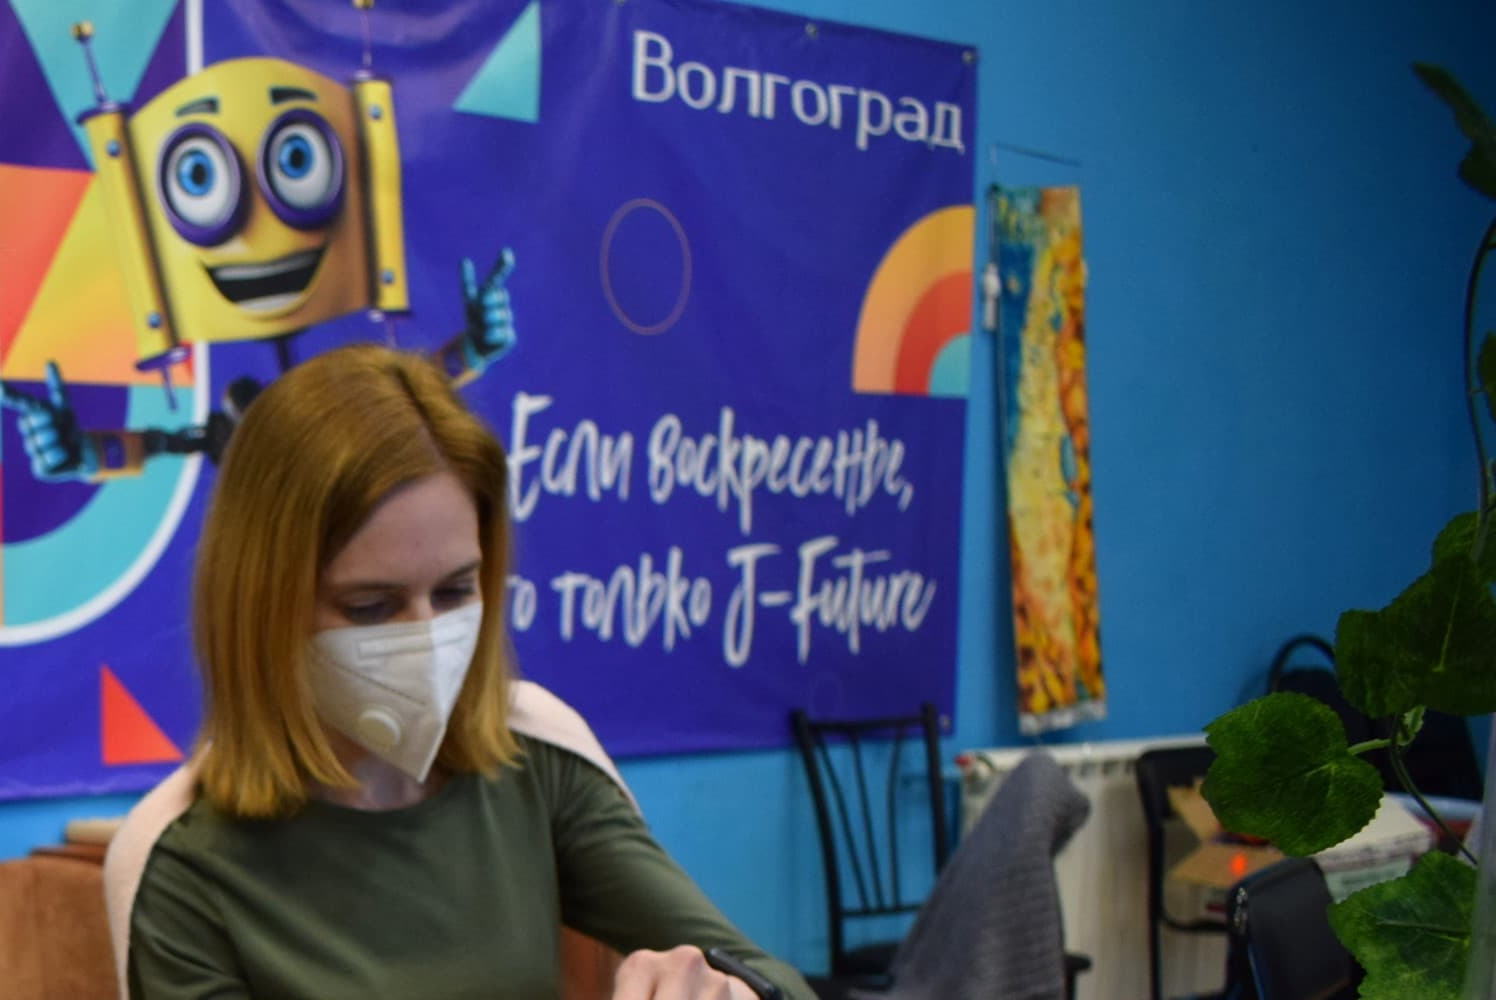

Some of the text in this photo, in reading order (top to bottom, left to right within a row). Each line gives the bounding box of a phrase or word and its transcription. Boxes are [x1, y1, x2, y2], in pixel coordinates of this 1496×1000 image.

[632, 29, 965, 154] Волгоград
[507, 392, 914, 535] Если воскресенье,
[551, 545, 712, 652] только
[723, 535, 937, 669] J-Future
